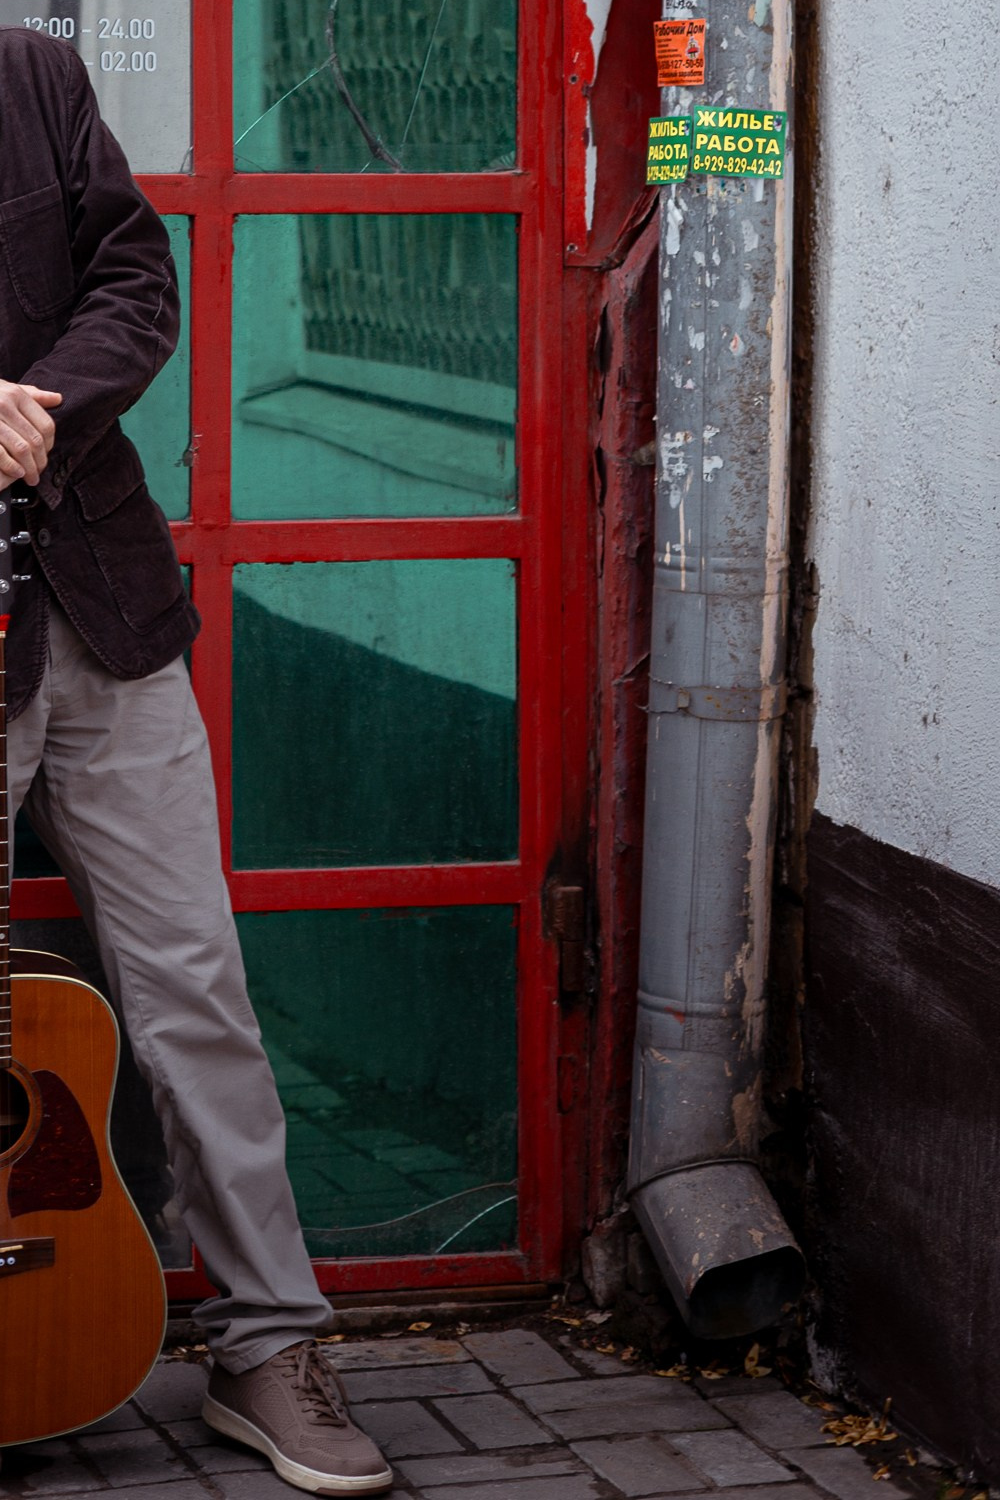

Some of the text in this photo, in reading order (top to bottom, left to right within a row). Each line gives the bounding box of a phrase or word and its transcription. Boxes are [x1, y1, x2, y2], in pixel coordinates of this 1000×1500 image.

[98, 18, 156, 40] 24.00
[100, 51, 157, 73] 02.00
[649, 120, 685, 138] ЖИЛЬЕ
[697, 110, 774, 131] ЖИЛЬЕ
[648, 143, 688, 160] РАБОТА
[696, 133, 780, 155] РАБОТА
[693, 154, 782, 176] 8-929-829-42-42
